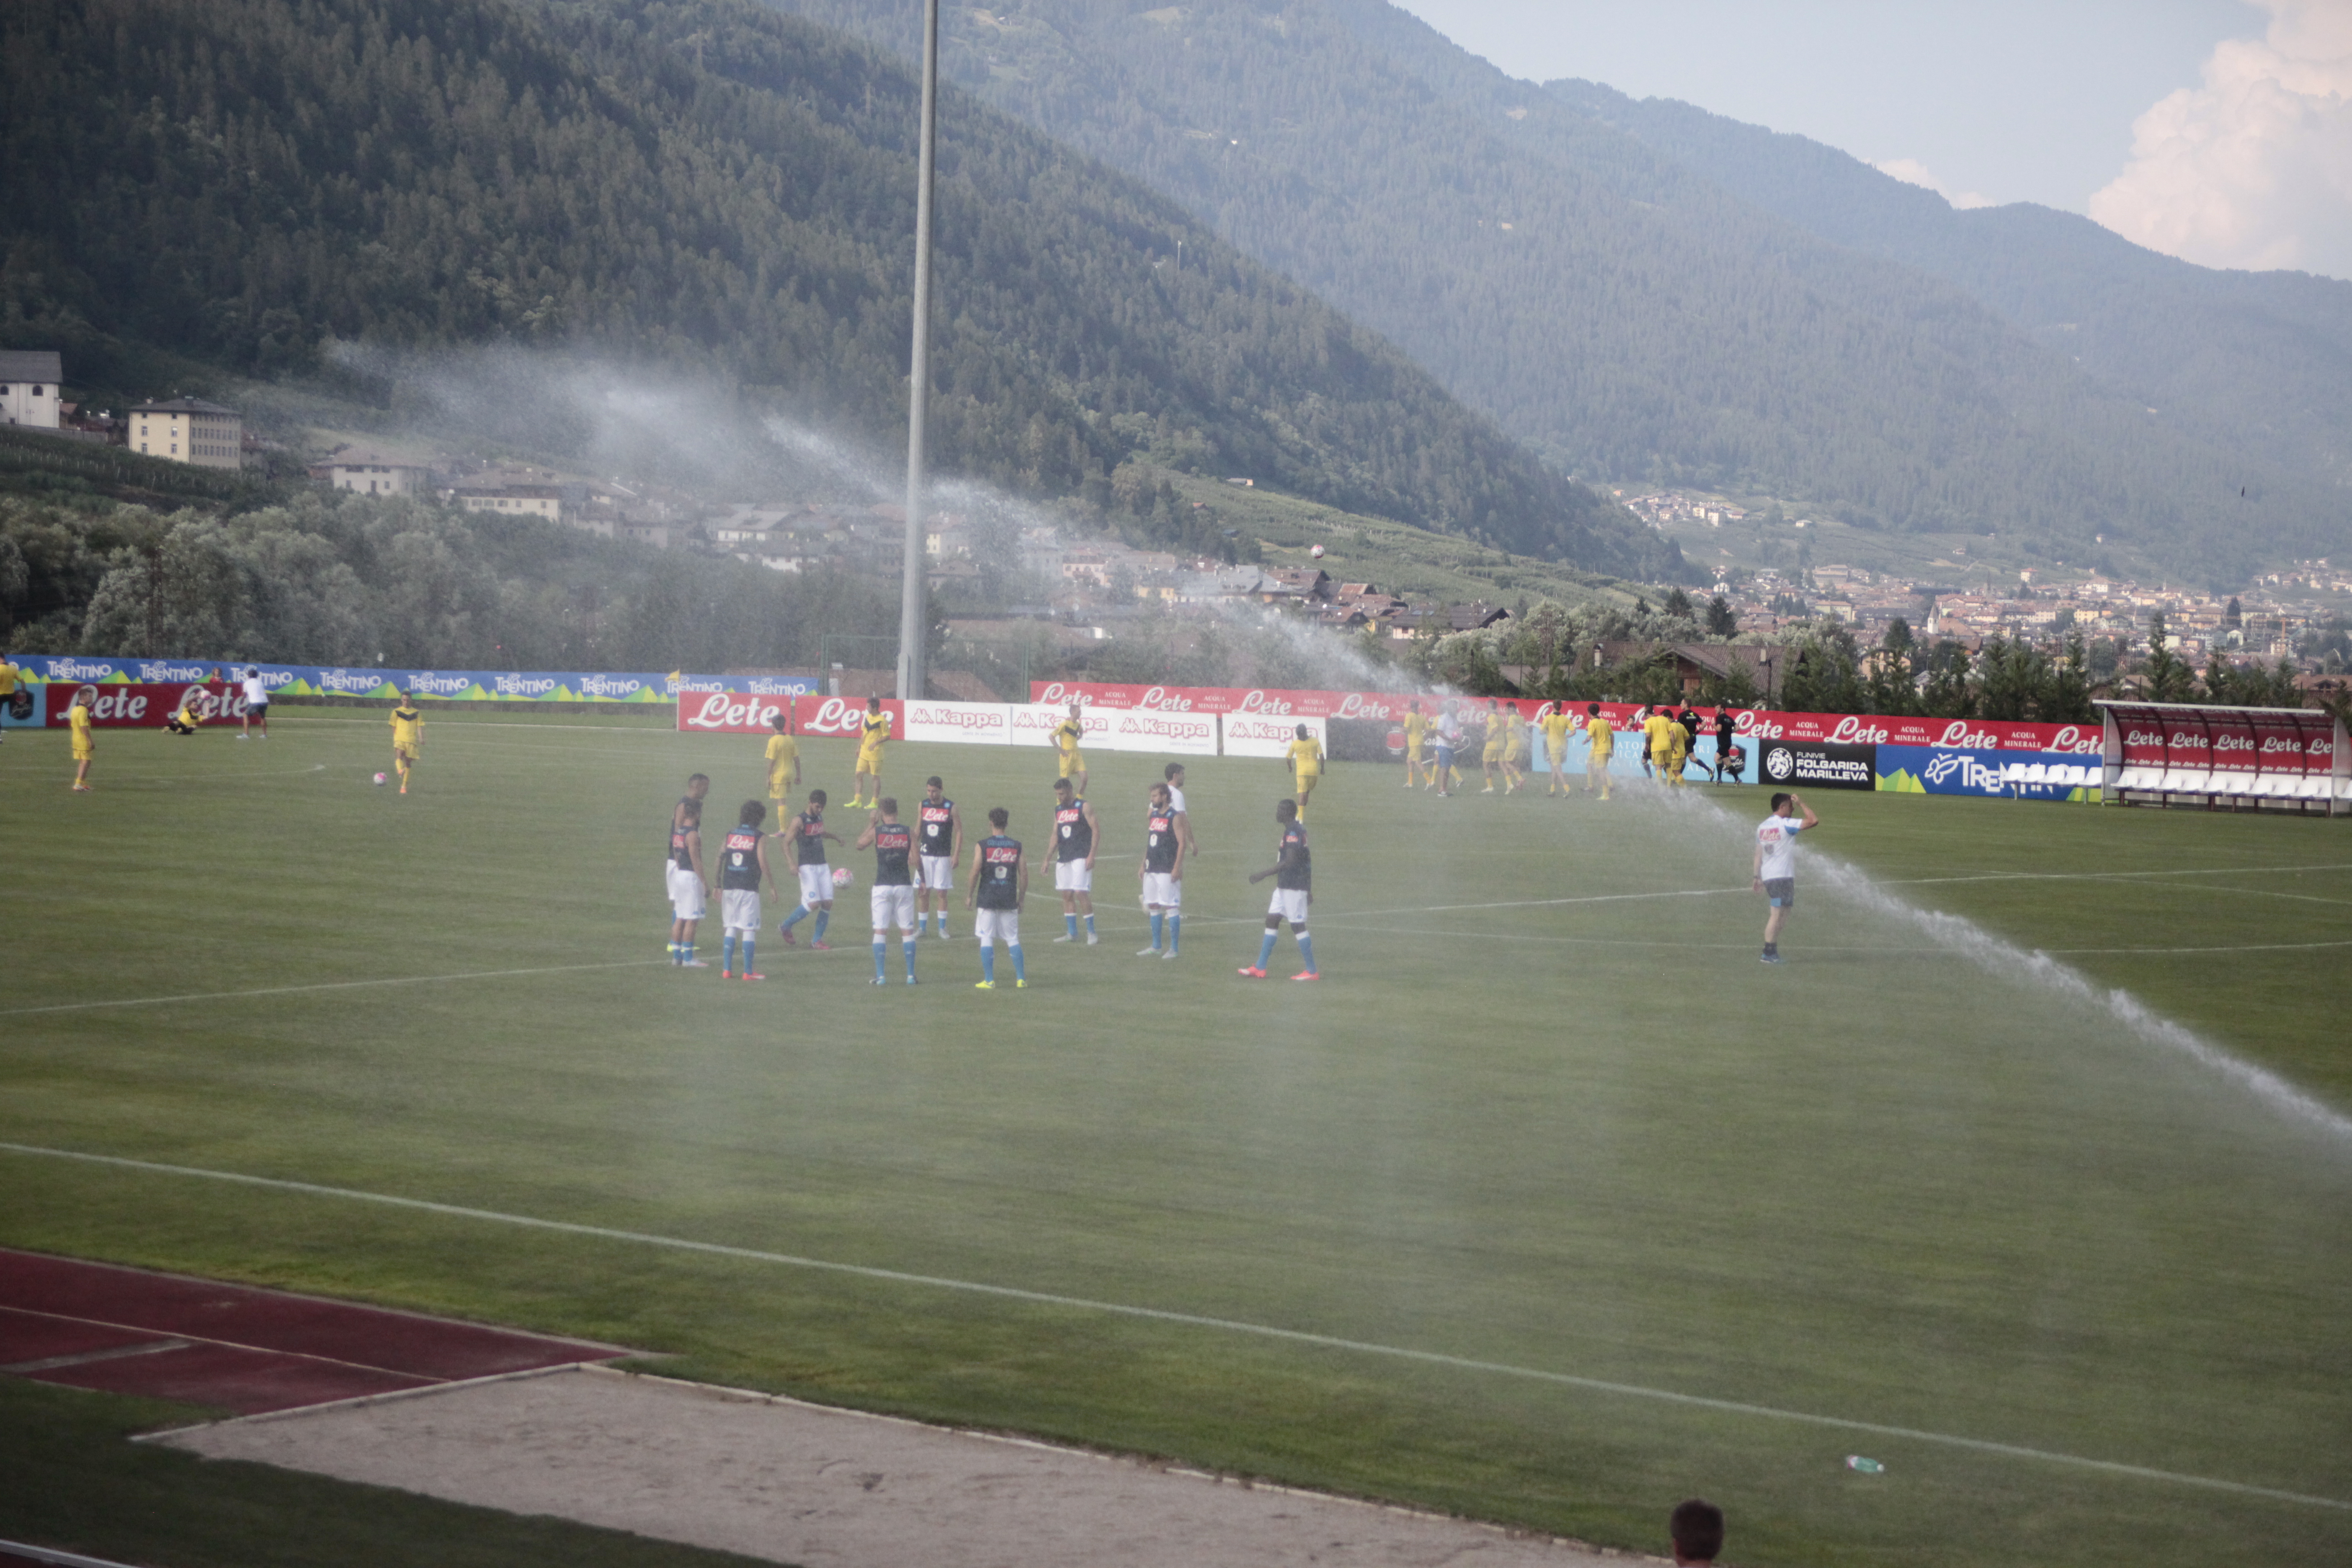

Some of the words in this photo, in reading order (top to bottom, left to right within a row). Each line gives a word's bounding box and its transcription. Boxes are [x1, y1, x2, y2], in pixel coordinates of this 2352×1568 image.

[47, 660, 112, 679] TRENTINO
[140, 664, 203, 681] TRENTINO
[320, 672, 382, 690] TRENTINO
[408, 675, 469, 692] TRENTINO
[495, 676, 554, 694] TRENTINO
[581, 678, 639, 694] TRENTINO
[748, 681, 806, 697] TRENTINO
[56, 684, 147, 720] Lete
[1032, 683, 1093, 707] Lete
[1132, 686, 1192, 712] Lete
[1232, 690, 1292, 715] Lete
[687, 693, 780, 727] Lete
[1330, 694, 1390, 719] Lete
[936, 709, 1003, 728] Kappa
[1039, 713, 1108, 733] Kapa
[1731, 711, 1783, 739] Lete
[1143, 718, 1210, 739] Kappa
[1823, 716, 1888, 744] Lete
[1930, 721, 1998, 749] Lete
[2123, 730, 2163, 746] Lete
[2167, 732, 2208, 748] Lete
[2213, 734, 2254, 750] Lete
[2259, 736, 2301, 753] Lete
[2305, 738, 2332, 755] Le
[1796, 758, 1869, 771] FOLGARIDA
[1796, 769, 1869, 781] MARILLEVA
[923, 808, 949, 821] Lete
[1057, 810, 1078, 823] Lete
[1149, 818, 1168, 831] Lete
[727, 835, 754, 849] Lete
[877, 835, 908, 848] Lete
[987, 847, 1017, 863] Lete
